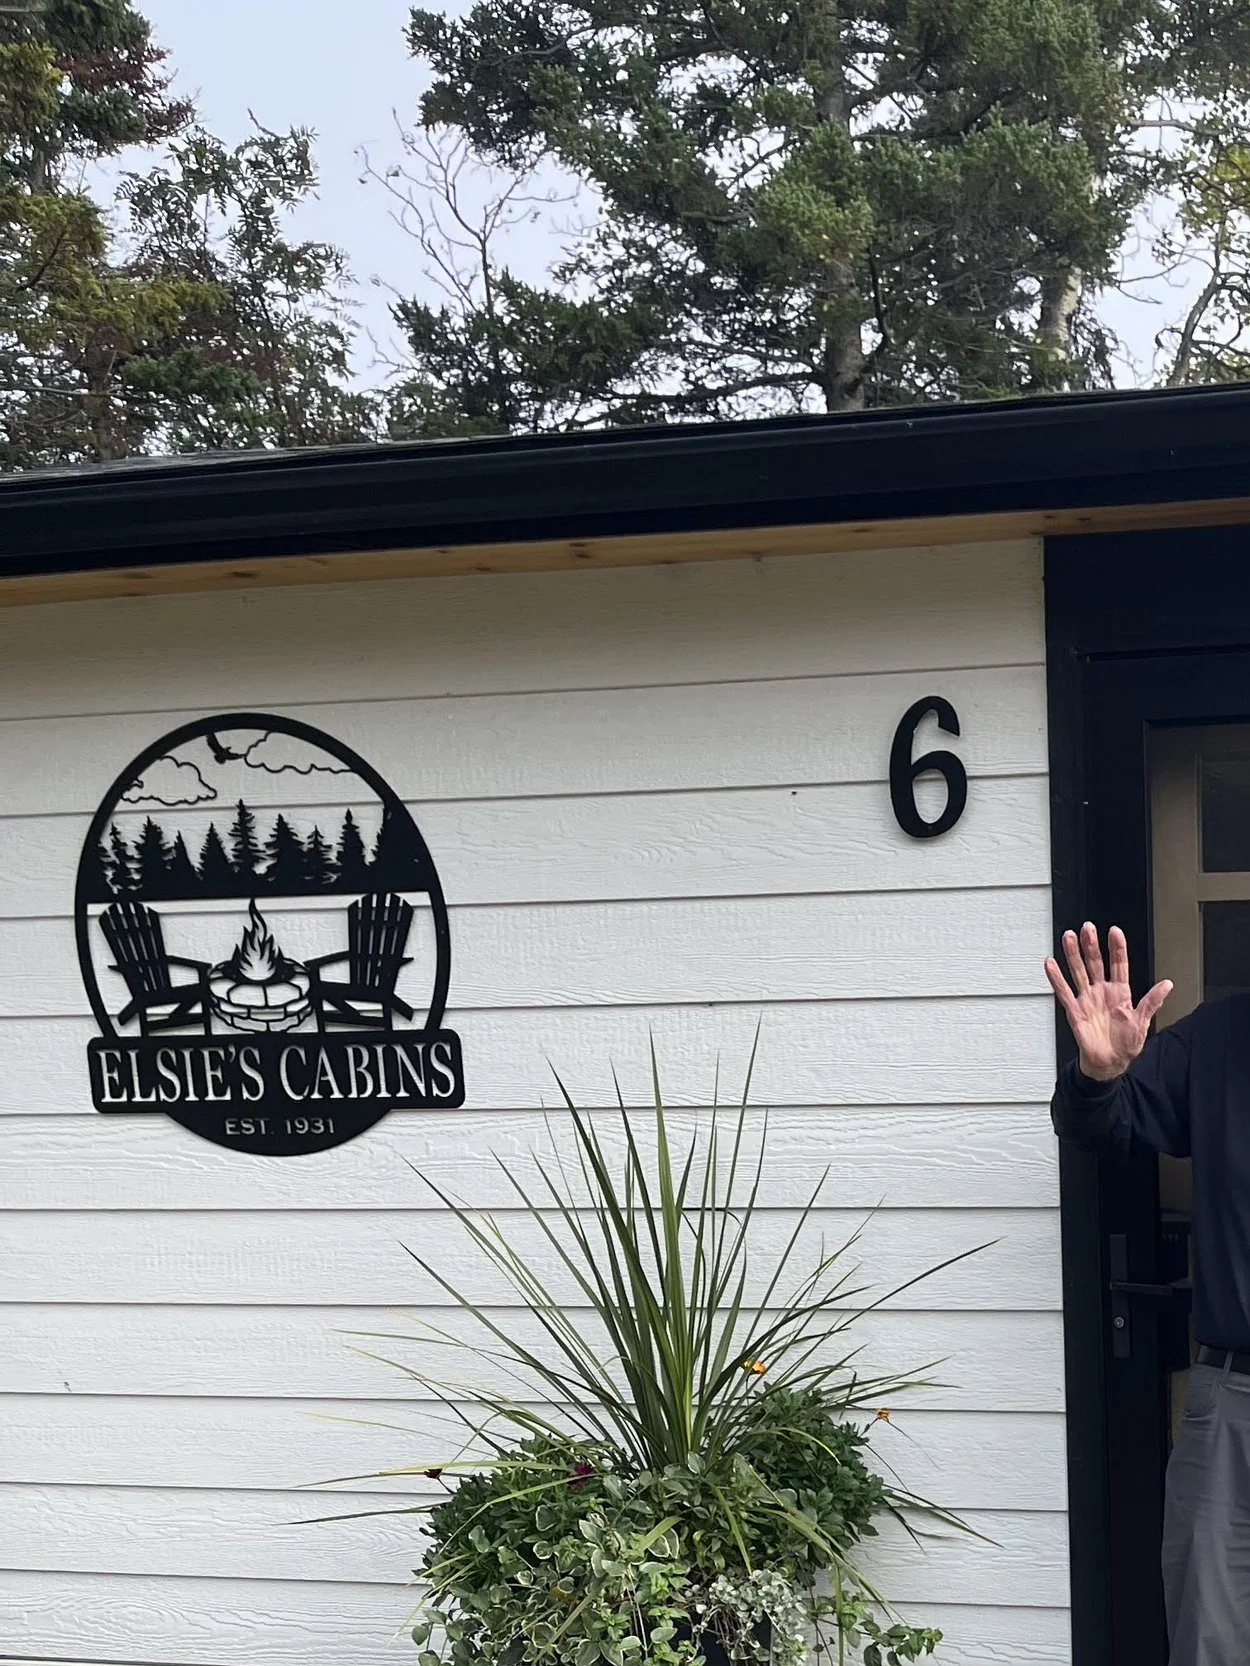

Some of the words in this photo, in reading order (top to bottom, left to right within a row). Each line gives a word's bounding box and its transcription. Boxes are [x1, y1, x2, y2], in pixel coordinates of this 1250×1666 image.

[889, 696, 968, 838] 6
[96, 1044, 265, 1104] ELSIE'S
[280, 1042, 456, 1101] CABINS
[286, 1117, 336, 1135] 1931
